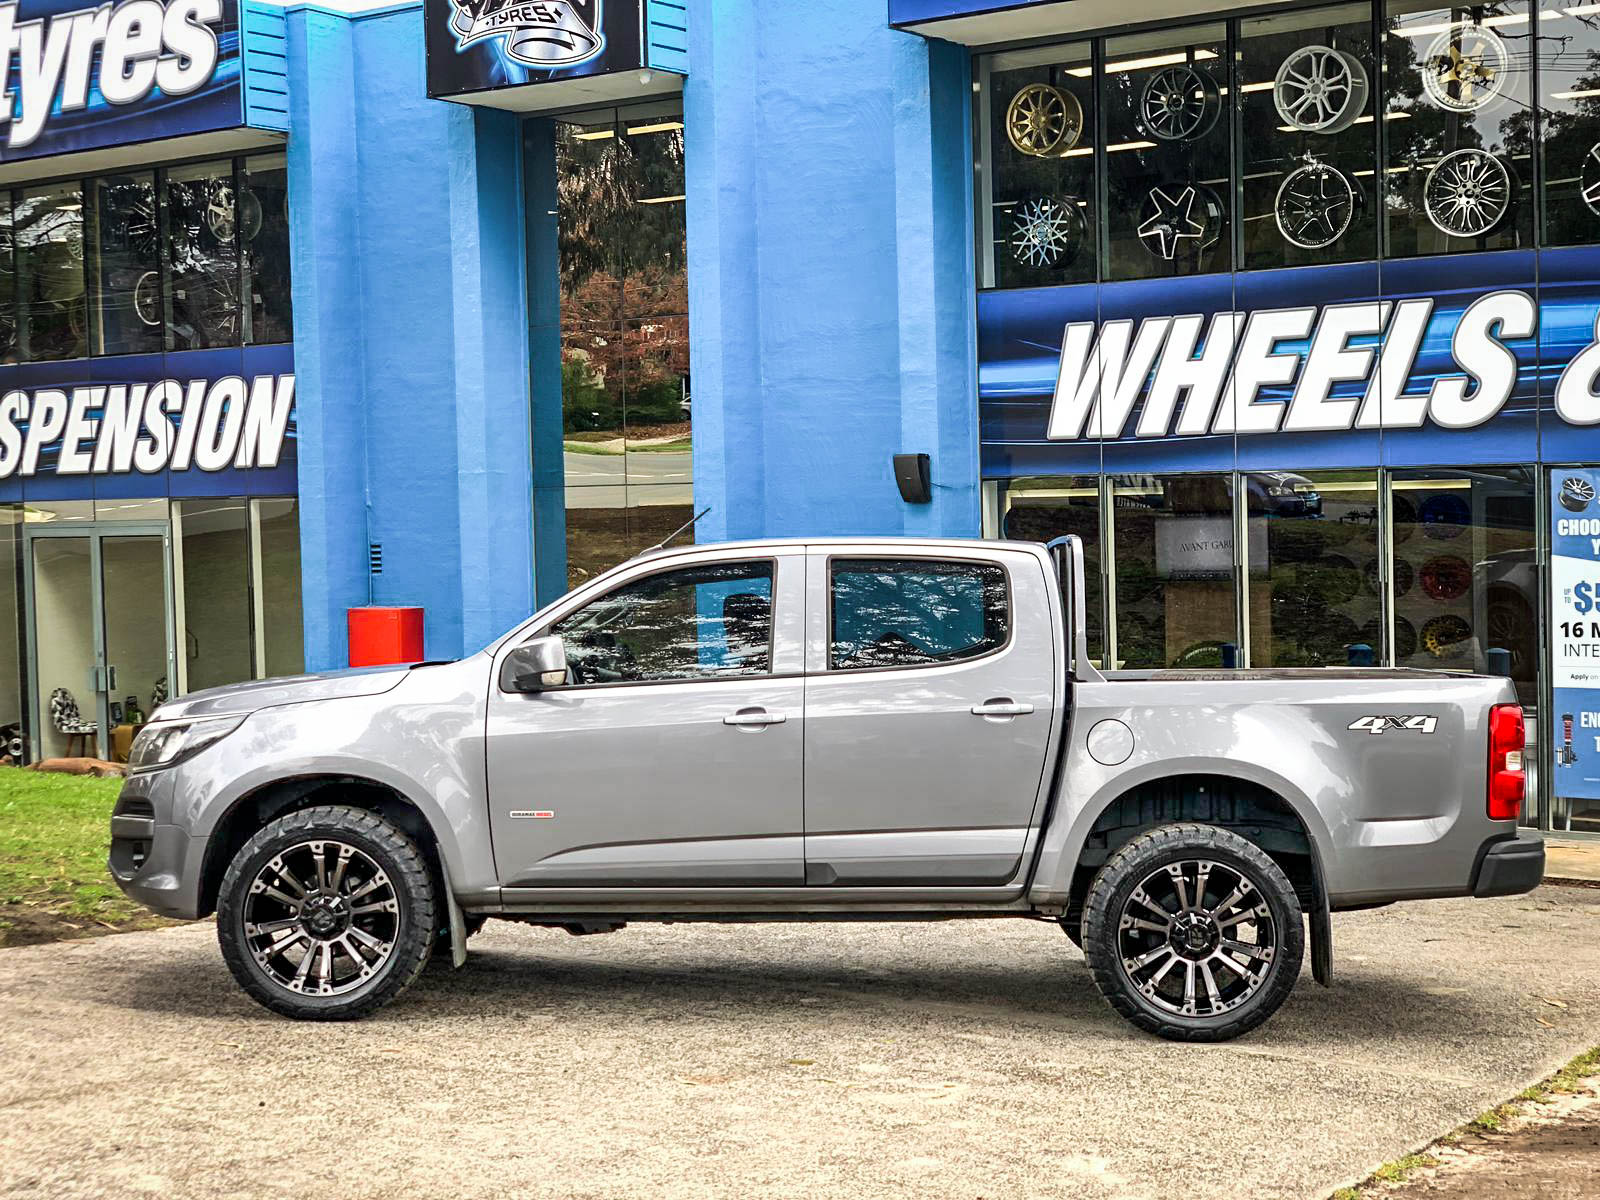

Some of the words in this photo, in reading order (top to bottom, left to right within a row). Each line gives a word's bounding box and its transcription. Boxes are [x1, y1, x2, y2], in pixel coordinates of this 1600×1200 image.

[491, 4, 557, 27] TYRES
[1046, 289, 1537, 440] WHEELS
[0, 374, 296, 479] SPENSION
[1179, 541, 1209, 552] AVANT
[1560, 621, 1584, 638] 16
[1564, 643, 1600, 657] INTE
[1570, 673, 1589, 681] Apply
[1580, 711, 1600, 728] EN
